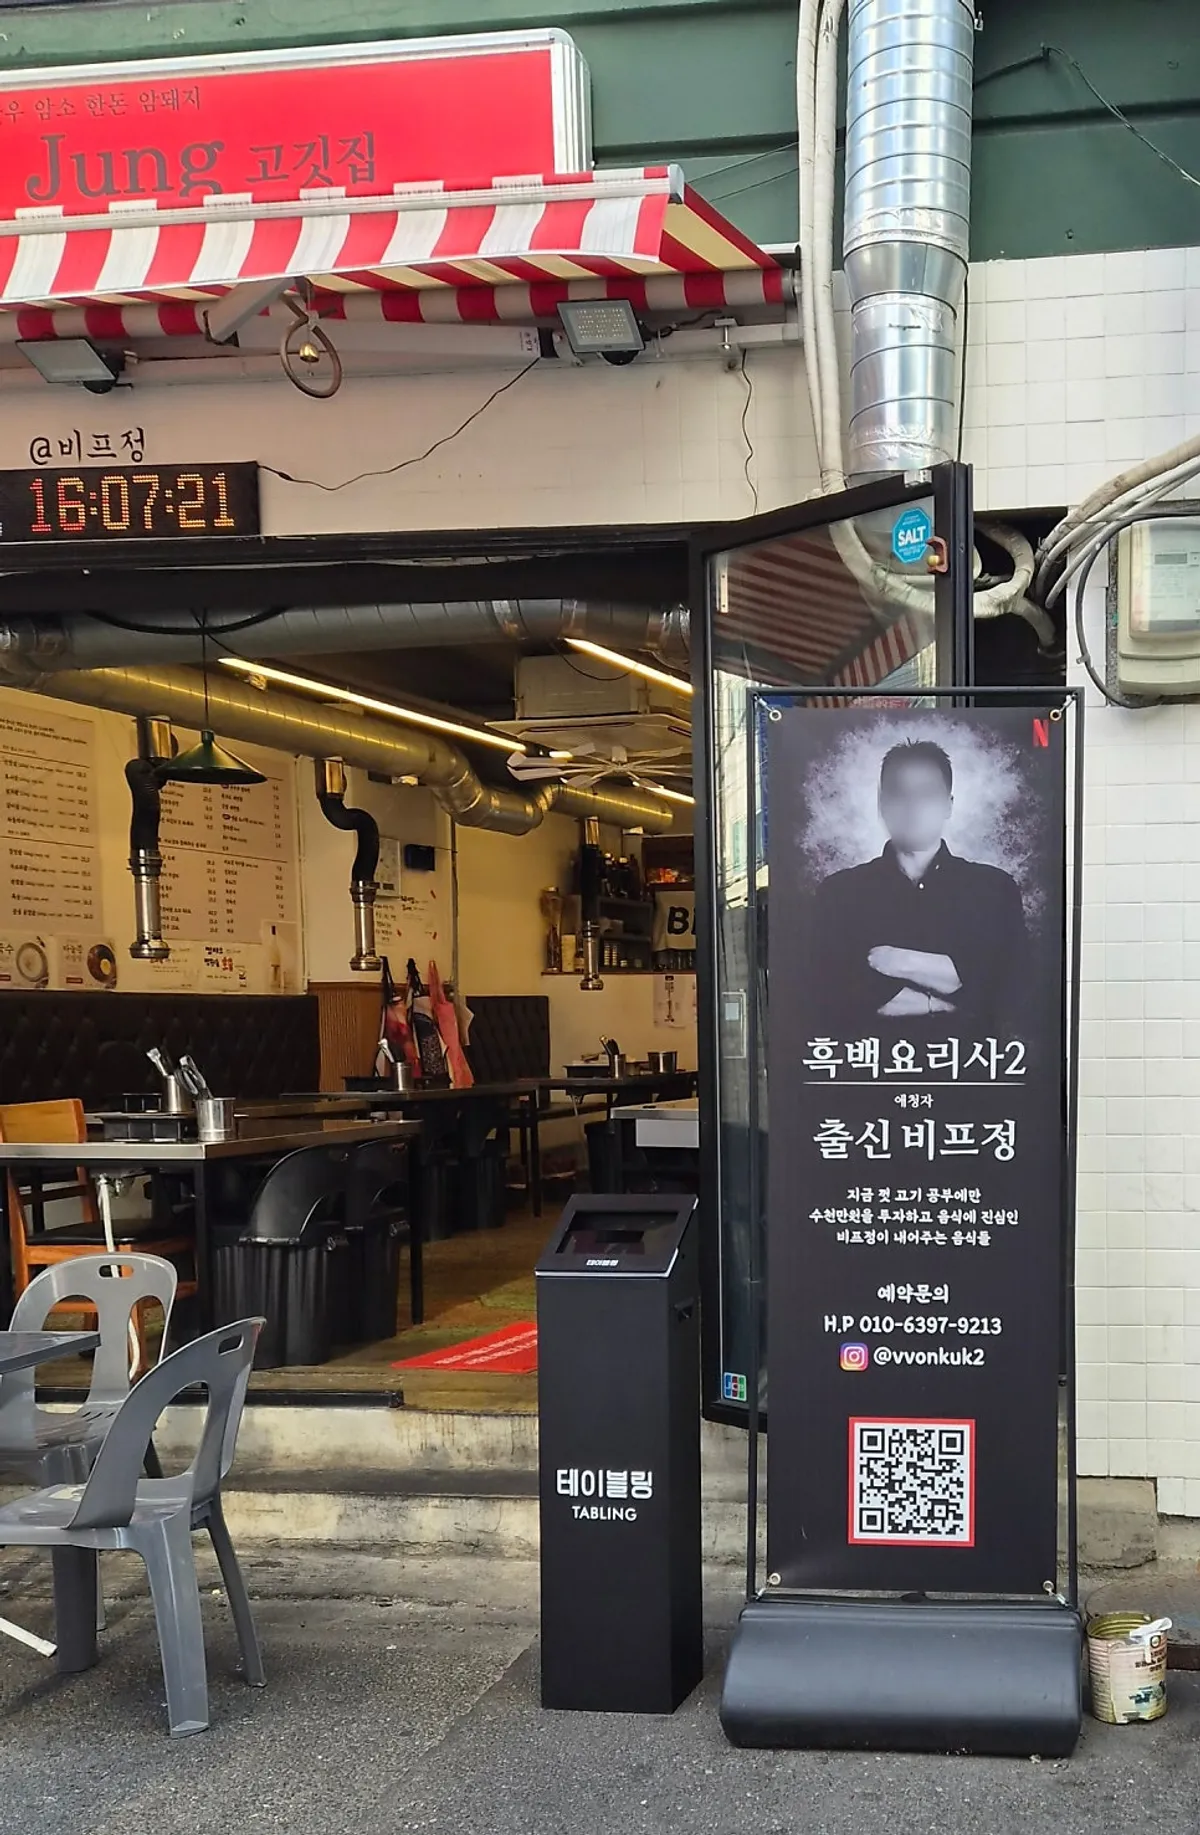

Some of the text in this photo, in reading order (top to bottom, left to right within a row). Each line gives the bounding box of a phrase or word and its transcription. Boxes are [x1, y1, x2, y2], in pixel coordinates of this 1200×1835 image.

[0, 85, 200, 125] 우 암소 한돈 암돼지
[26, 131, 375, 201] Jung 고깃집
[29, 427, 146, 465] @비프정
[29, 472, 235, 532] 16:07:21
[897, 525, 927, 547] SALT
[1032, 718, 1049, 748] N
[667, 905, 696, 935] B
[803, 1037, 1027, 1080] 흑백요리사2
[813, 1118, 1016, 1161] 출신 비프정
[846, 1187, 875, 1202] 지금
[895, 1187, 922, 1202] 고기
[926, 1187, 982, 1203] 공부에만
[808, 1208, 1019, 1225] 수천만원을 투자하고 음식에 진심인
[836, 1229, 991, 1246] 비프정이 내어주는 음식들
[877, 1283, 949, 1304] 예약문의
[823, 1314, 1002, 1335] H.P 010-6397-9213
[873, 1346, 985, 1366] @vvonkuk2
[556, 1468, 653, 1499] 테이블링
[571, 1505, 637, 1521] TABLING
